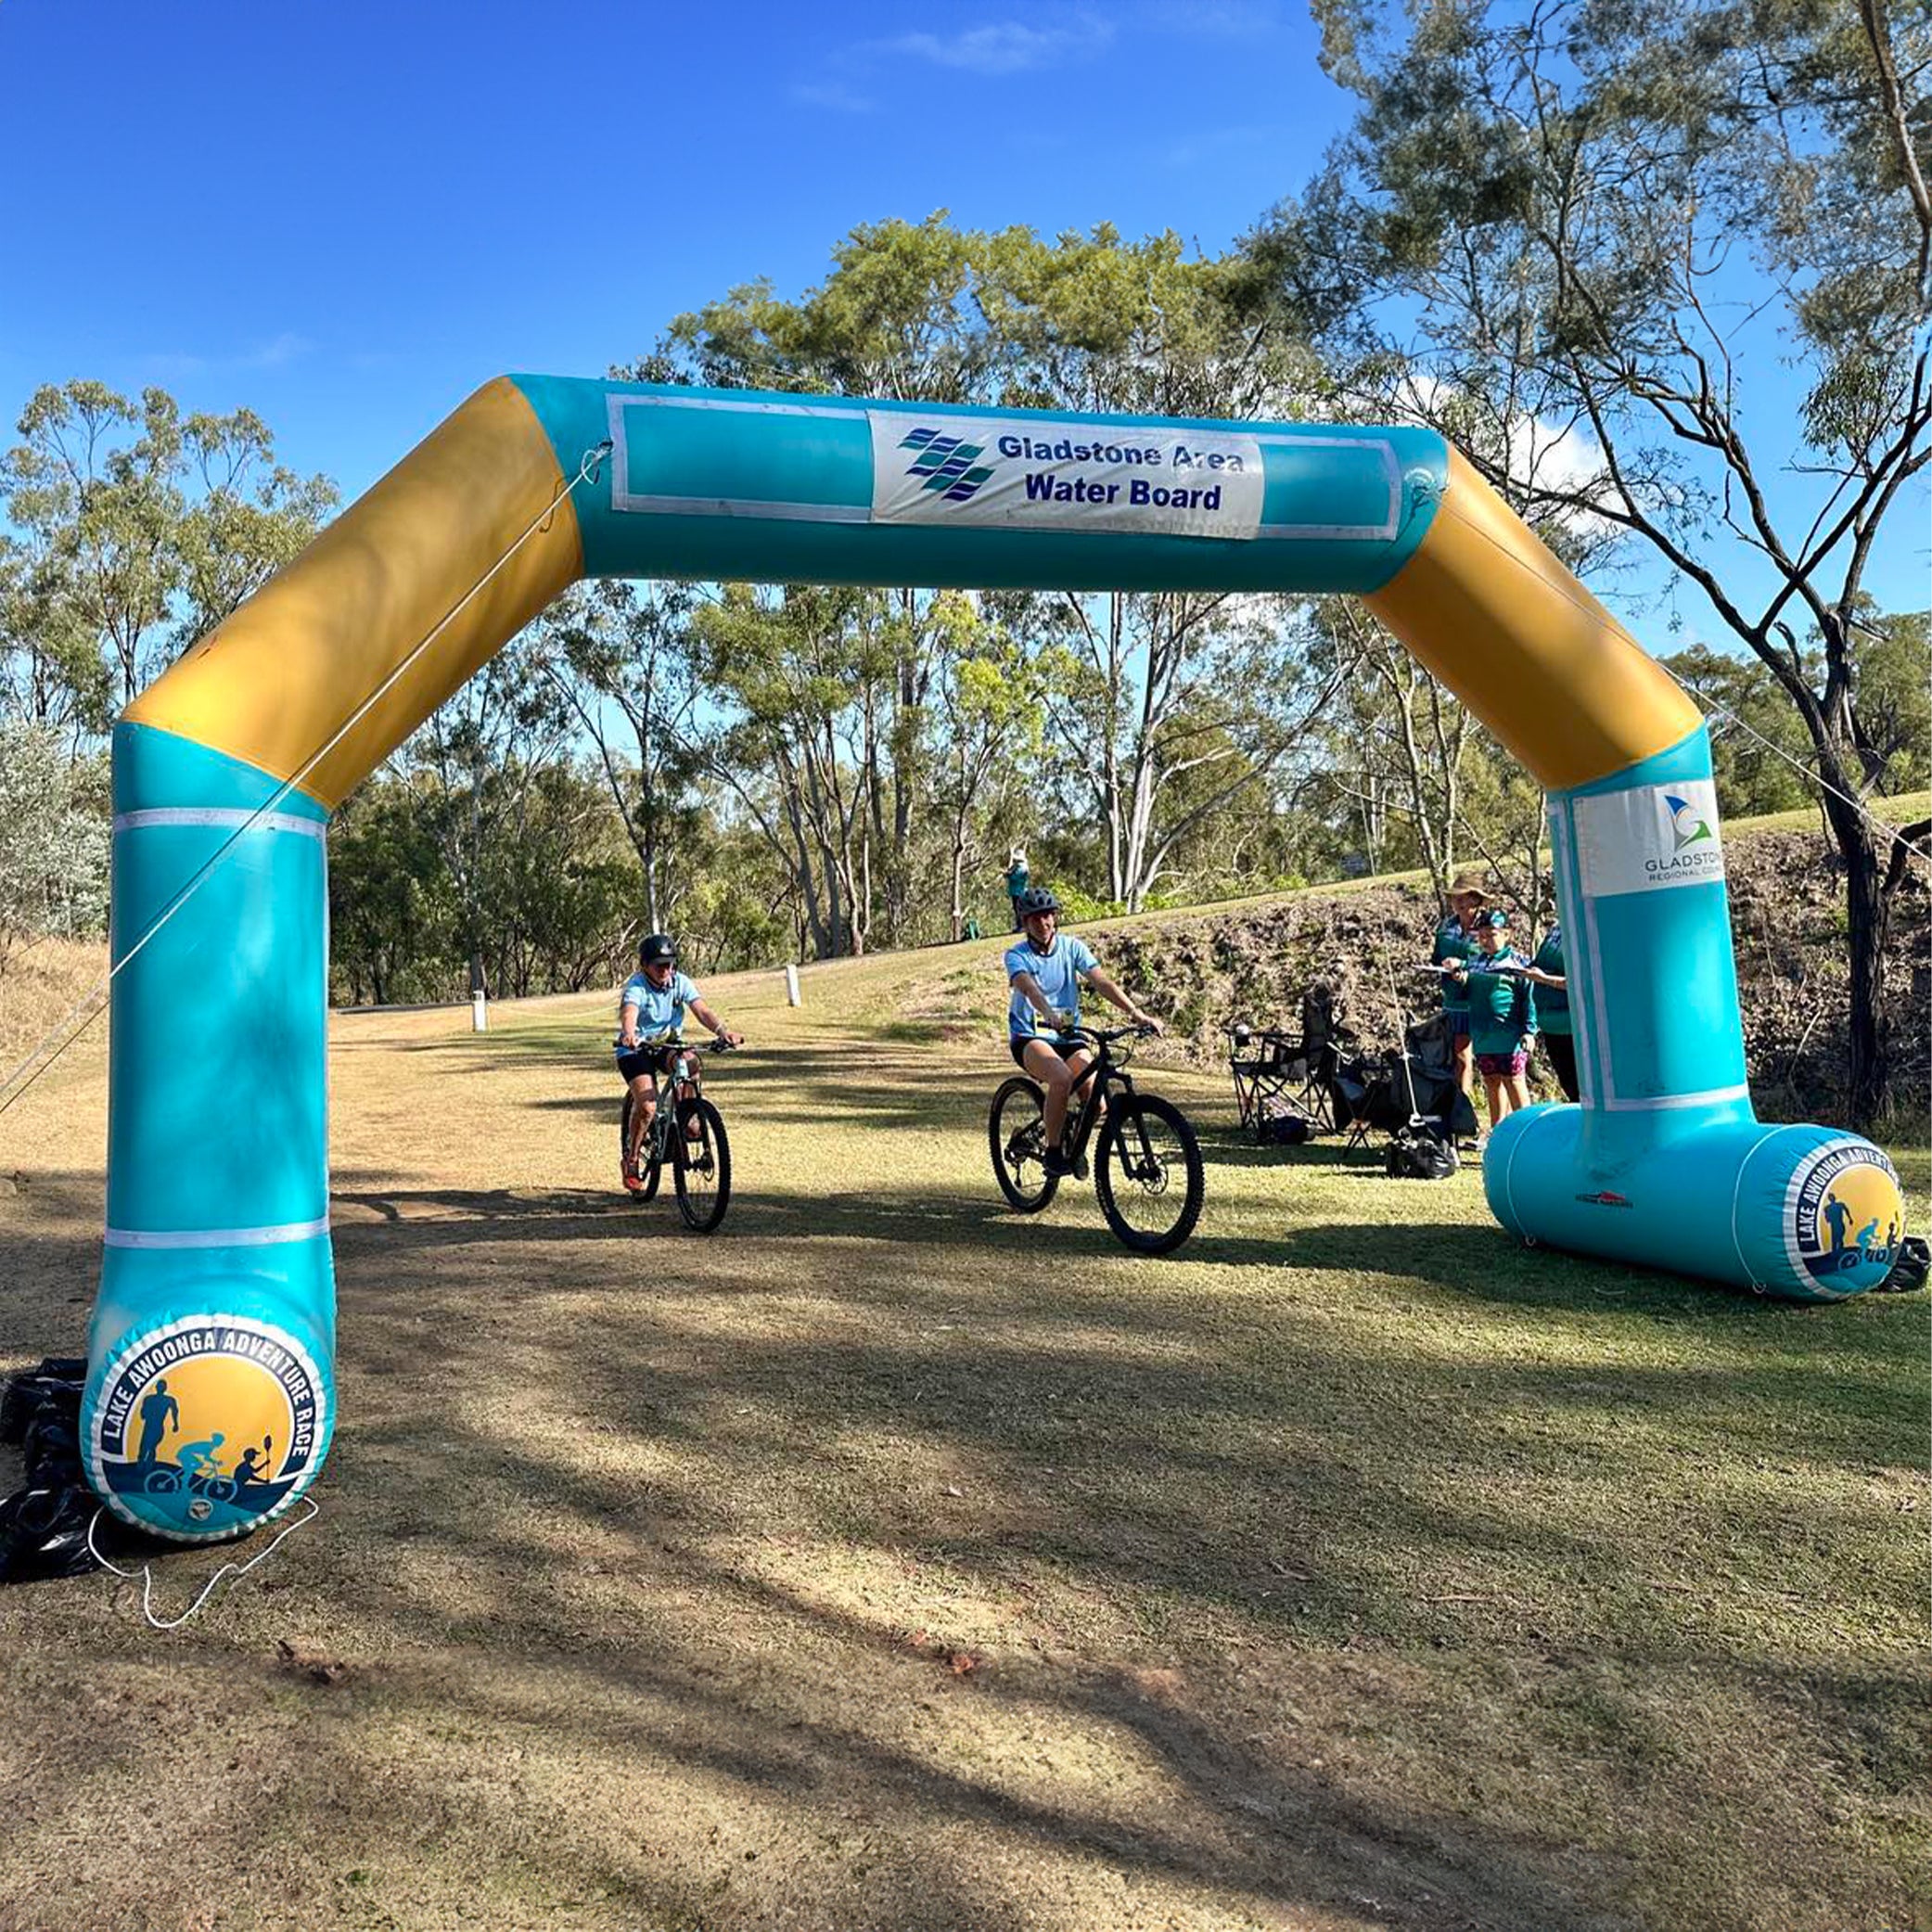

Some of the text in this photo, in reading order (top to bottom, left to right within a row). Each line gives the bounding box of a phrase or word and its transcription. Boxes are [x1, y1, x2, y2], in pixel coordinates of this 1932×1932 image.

[998, 436, 1244, 472] Gladstone Area
[1025, 473, 1222, 511] Water Board
[1802, 1151, 1849, 1205] AWOONGA
[1799, 1204, 1816, 1243] LAKE
[104, 1331, 313, 1458] LAKE AWOONGA ADVENTURE RACE
